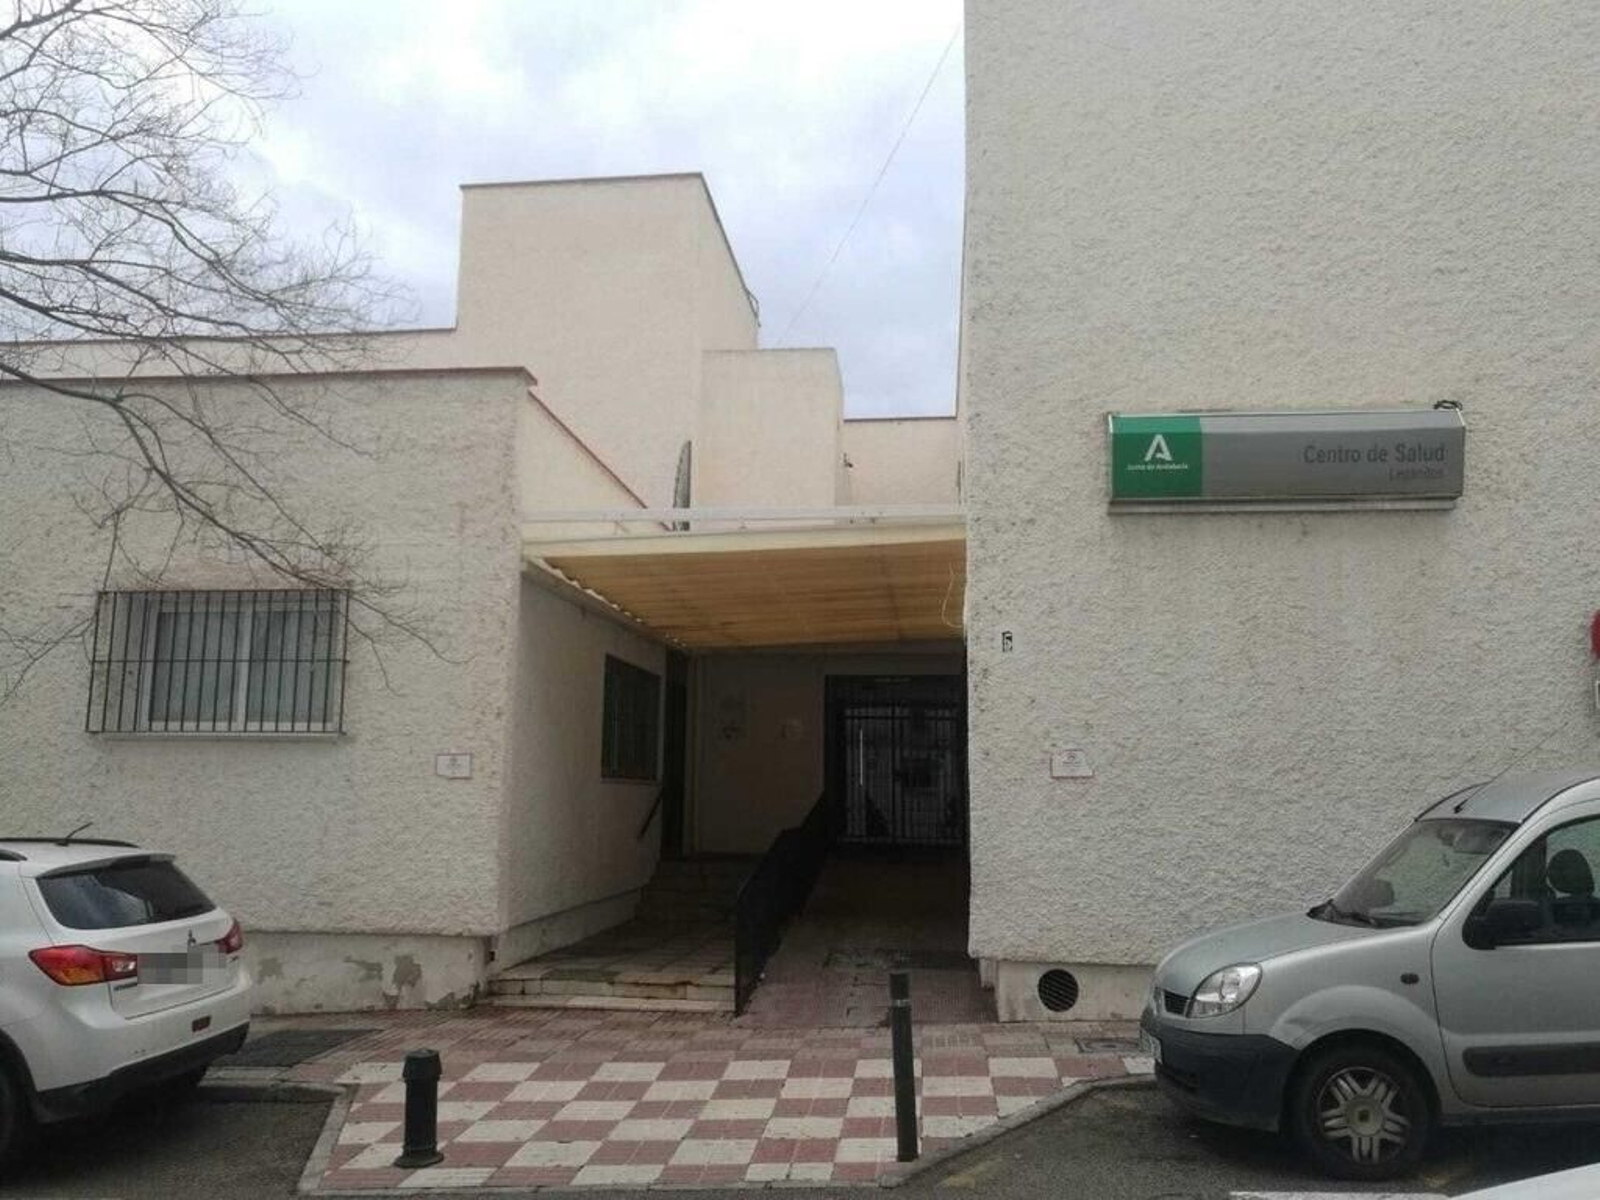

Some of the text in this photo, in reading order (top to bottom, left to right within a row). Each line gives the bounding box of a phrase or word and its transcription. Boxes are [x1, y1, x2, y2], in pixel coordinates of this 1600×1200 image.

[1303, 441, 1446, 463] Centro de Salud
